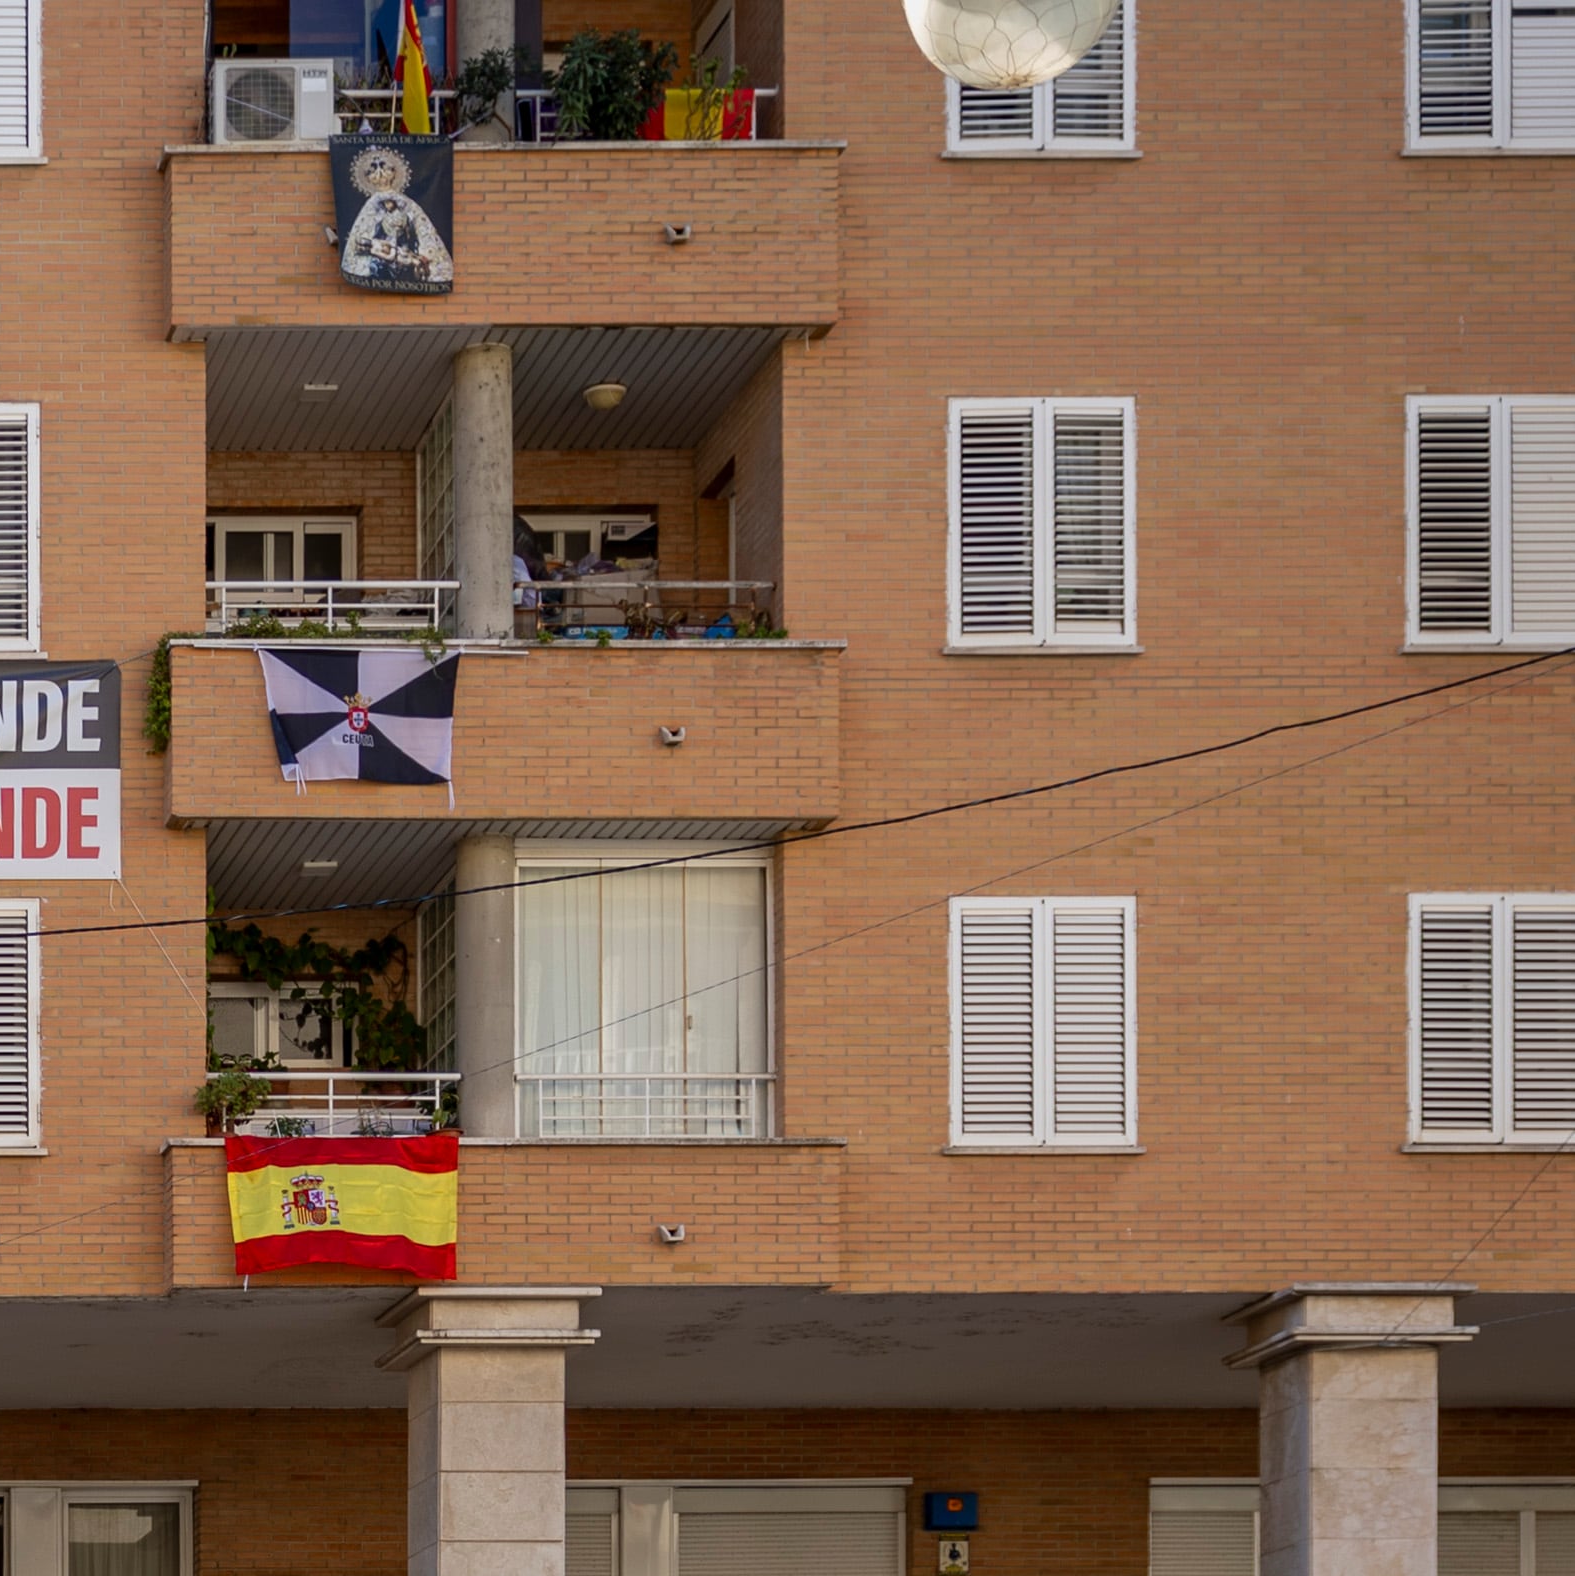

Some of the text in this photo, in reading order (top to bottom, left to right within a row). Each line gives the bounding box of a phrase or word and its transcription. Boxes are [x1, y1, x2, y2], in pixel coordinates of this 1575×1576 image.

[333, 136, 364, 144] SANTA
[400, 136, 413, 144] DE
[372, 278, 392, 288] POR
[395, 279, 451, 291] NOSOTROS
[342, 733, 375, 748] CEUTA
